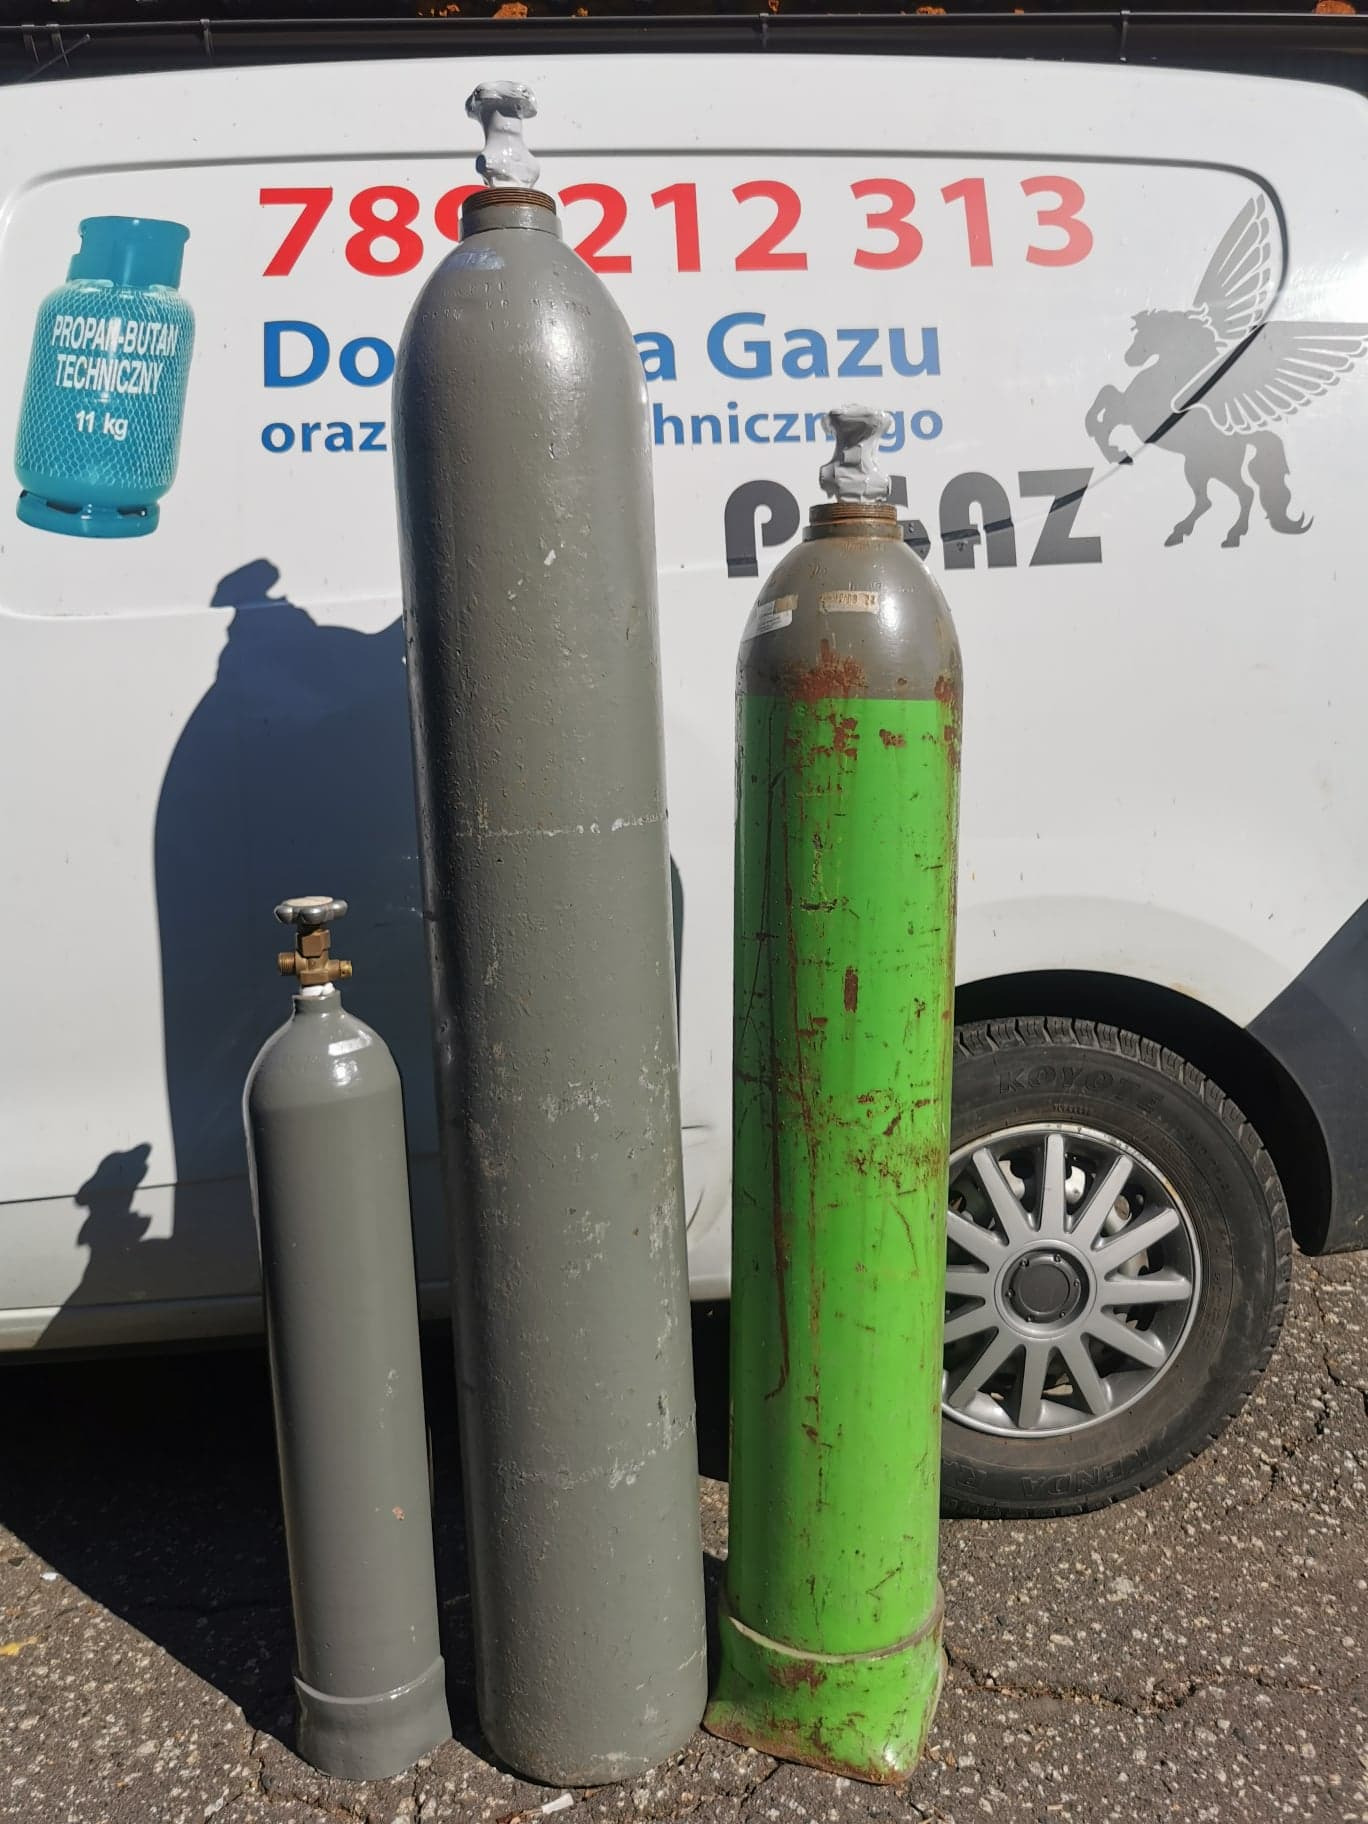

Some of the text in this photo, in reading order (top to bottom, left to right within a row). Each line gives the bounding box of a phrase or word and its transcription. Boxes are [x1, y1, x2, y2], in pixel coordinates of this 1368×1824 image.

[558, 181, 808, 273] 212
[852, 177, 1092, 269] 313
[52, 314, 179, 357] PROPAN-BUTAN
[708, 313, 940, 379] Gazu
[56, 353, 164, 395] TECHNICZNY
[76, 410, 128, 440] 11 kg
[261, 402, 943, 453] oraz hniczngo
[724, 468, 1103, 577] PAZ
